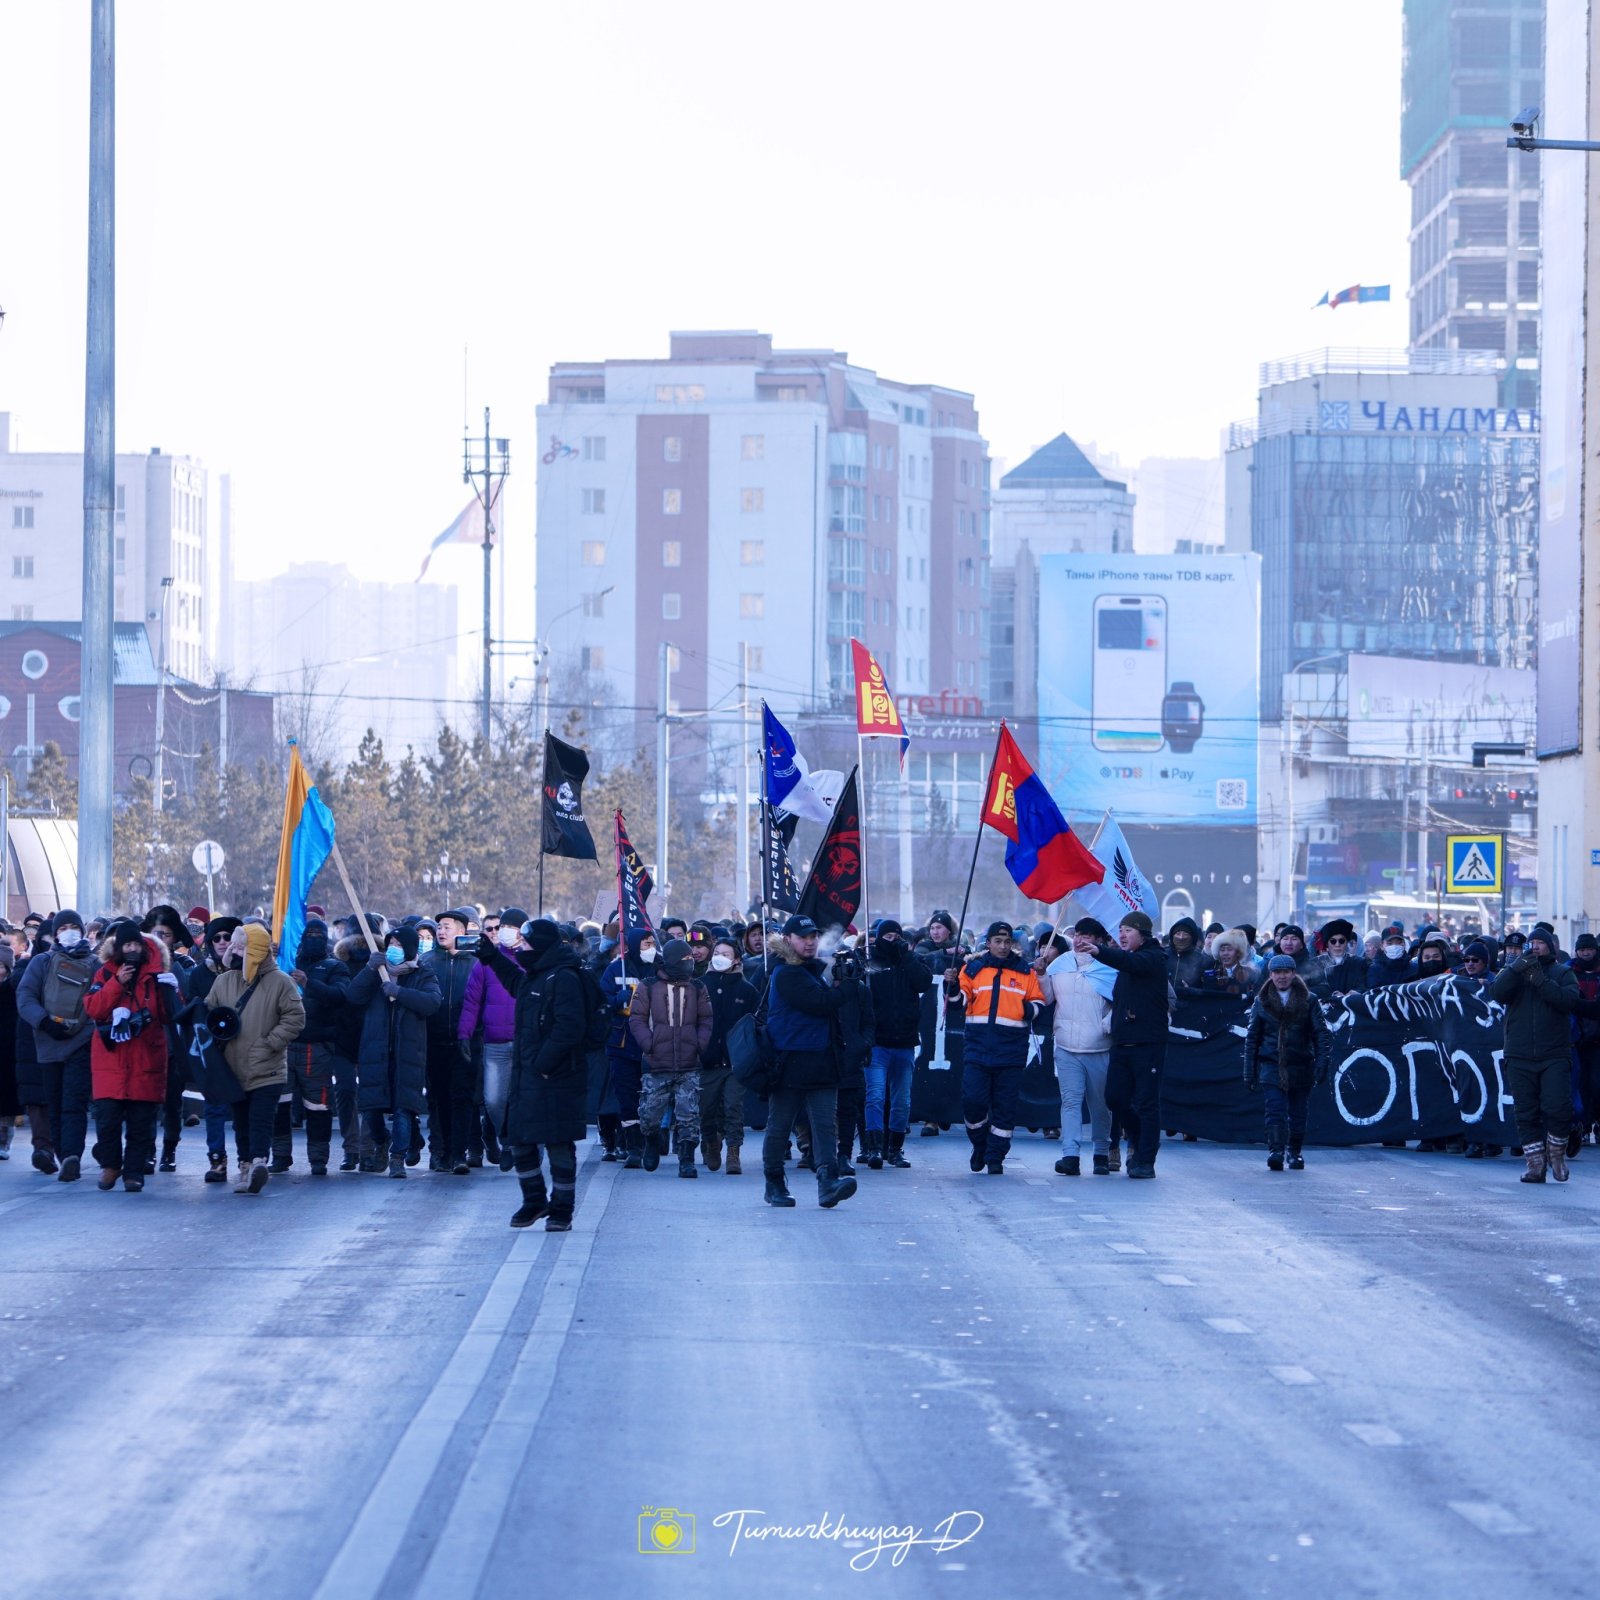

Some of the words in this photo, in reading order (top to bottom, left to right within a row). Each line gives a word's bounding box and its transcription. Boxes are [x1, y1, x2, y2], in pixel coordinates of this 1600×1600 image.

[1065, 569, 1095, 580] Таны
[1099, 570, 1140, 581] iPhone
[1143, 572, 1172, 581] таны
[1176, 570, 1201, 582] TDB
[1205, 573, 1235, 584] карт.
[1113, 766, 1143, 779] TDB
[1171, 768, 1195, 781] Pay
[1154, 871, 1252, 885] centre
